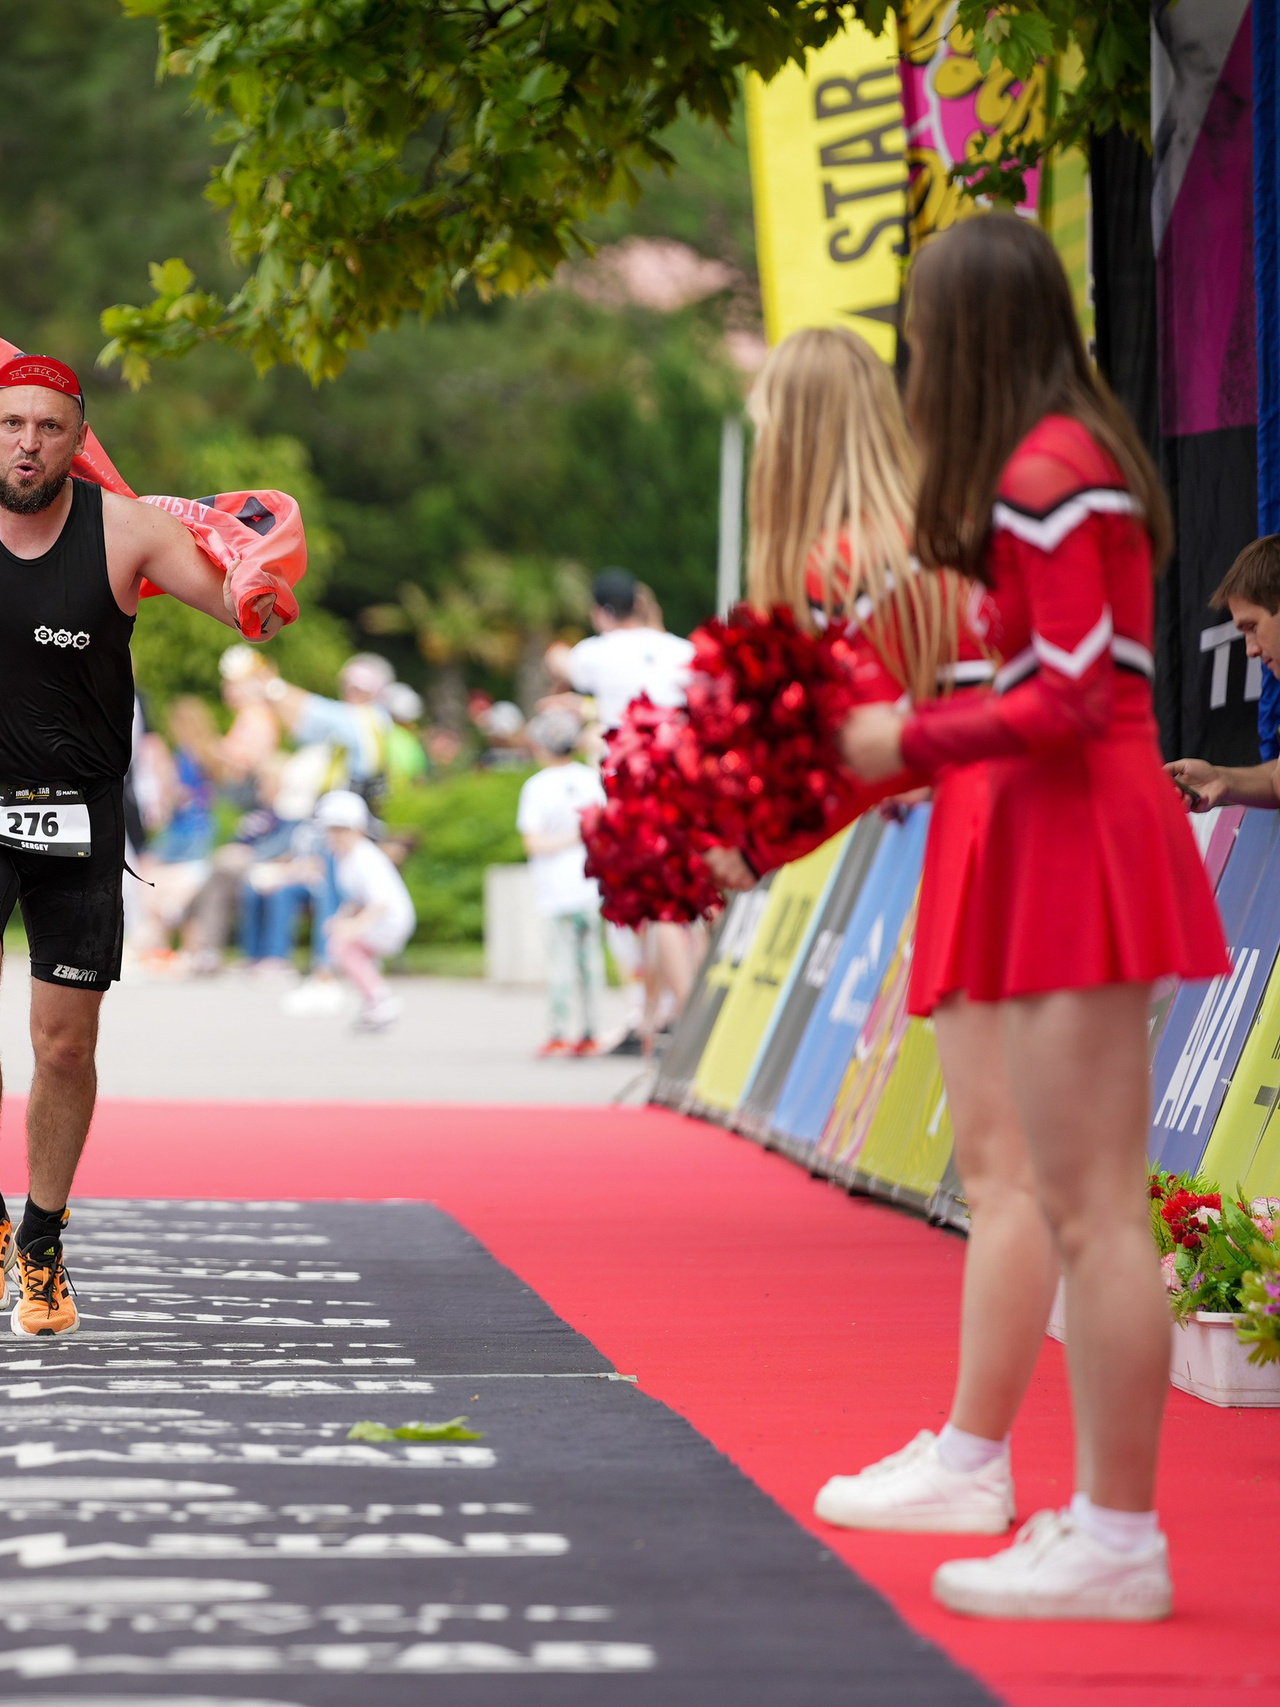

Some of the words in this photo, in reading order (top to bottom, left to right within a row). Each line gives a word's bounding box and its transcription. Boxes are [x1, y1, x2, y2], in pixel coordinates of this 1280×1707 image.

[814, 64, 910, 263] STAR
[7, 811, 59, 837] 276
[20, 841, 49, 852] SERGEY
[108, 1309, 391, 1326] STAR
[107, 1380, 435, 1392] STAR
